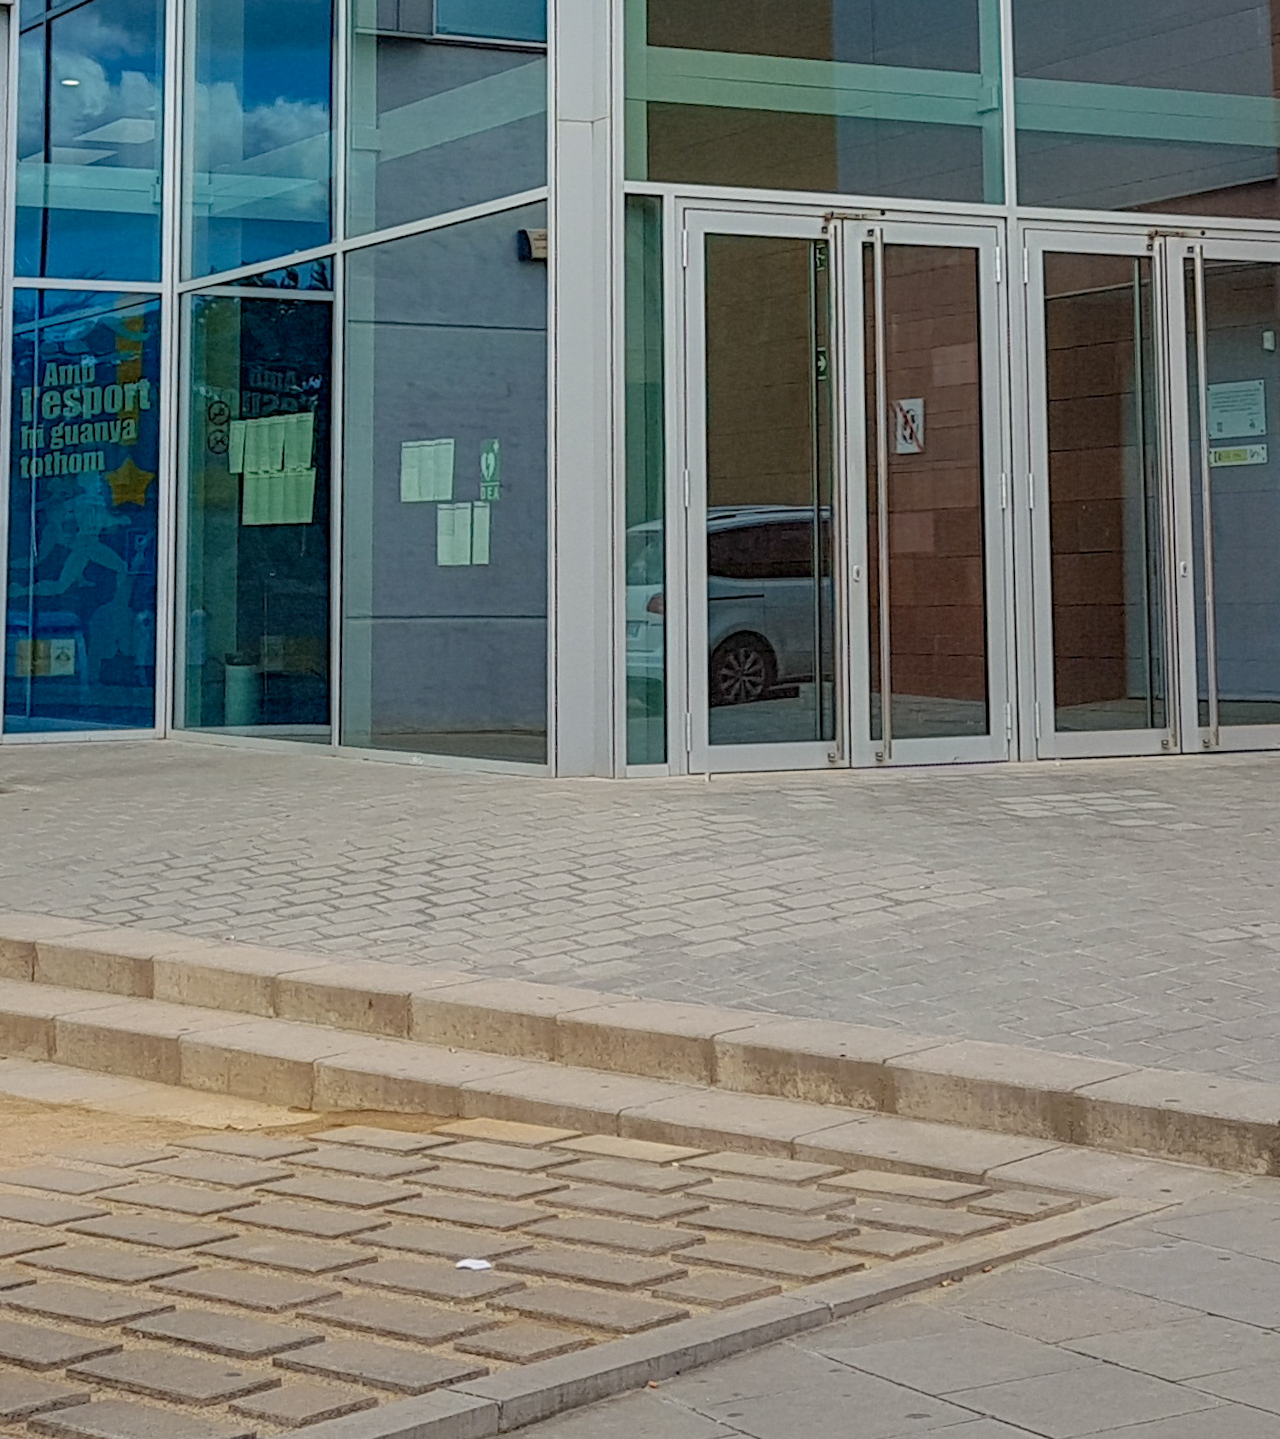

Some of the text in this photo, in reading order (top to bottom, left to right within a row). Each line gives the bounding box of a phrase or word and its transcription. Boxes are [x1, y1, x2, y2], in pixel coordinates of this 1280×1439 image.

[43, 362, 96, 387] Amb
[50, 419, 137, 450] guanya
[20, 450, 106, 479] tothom
